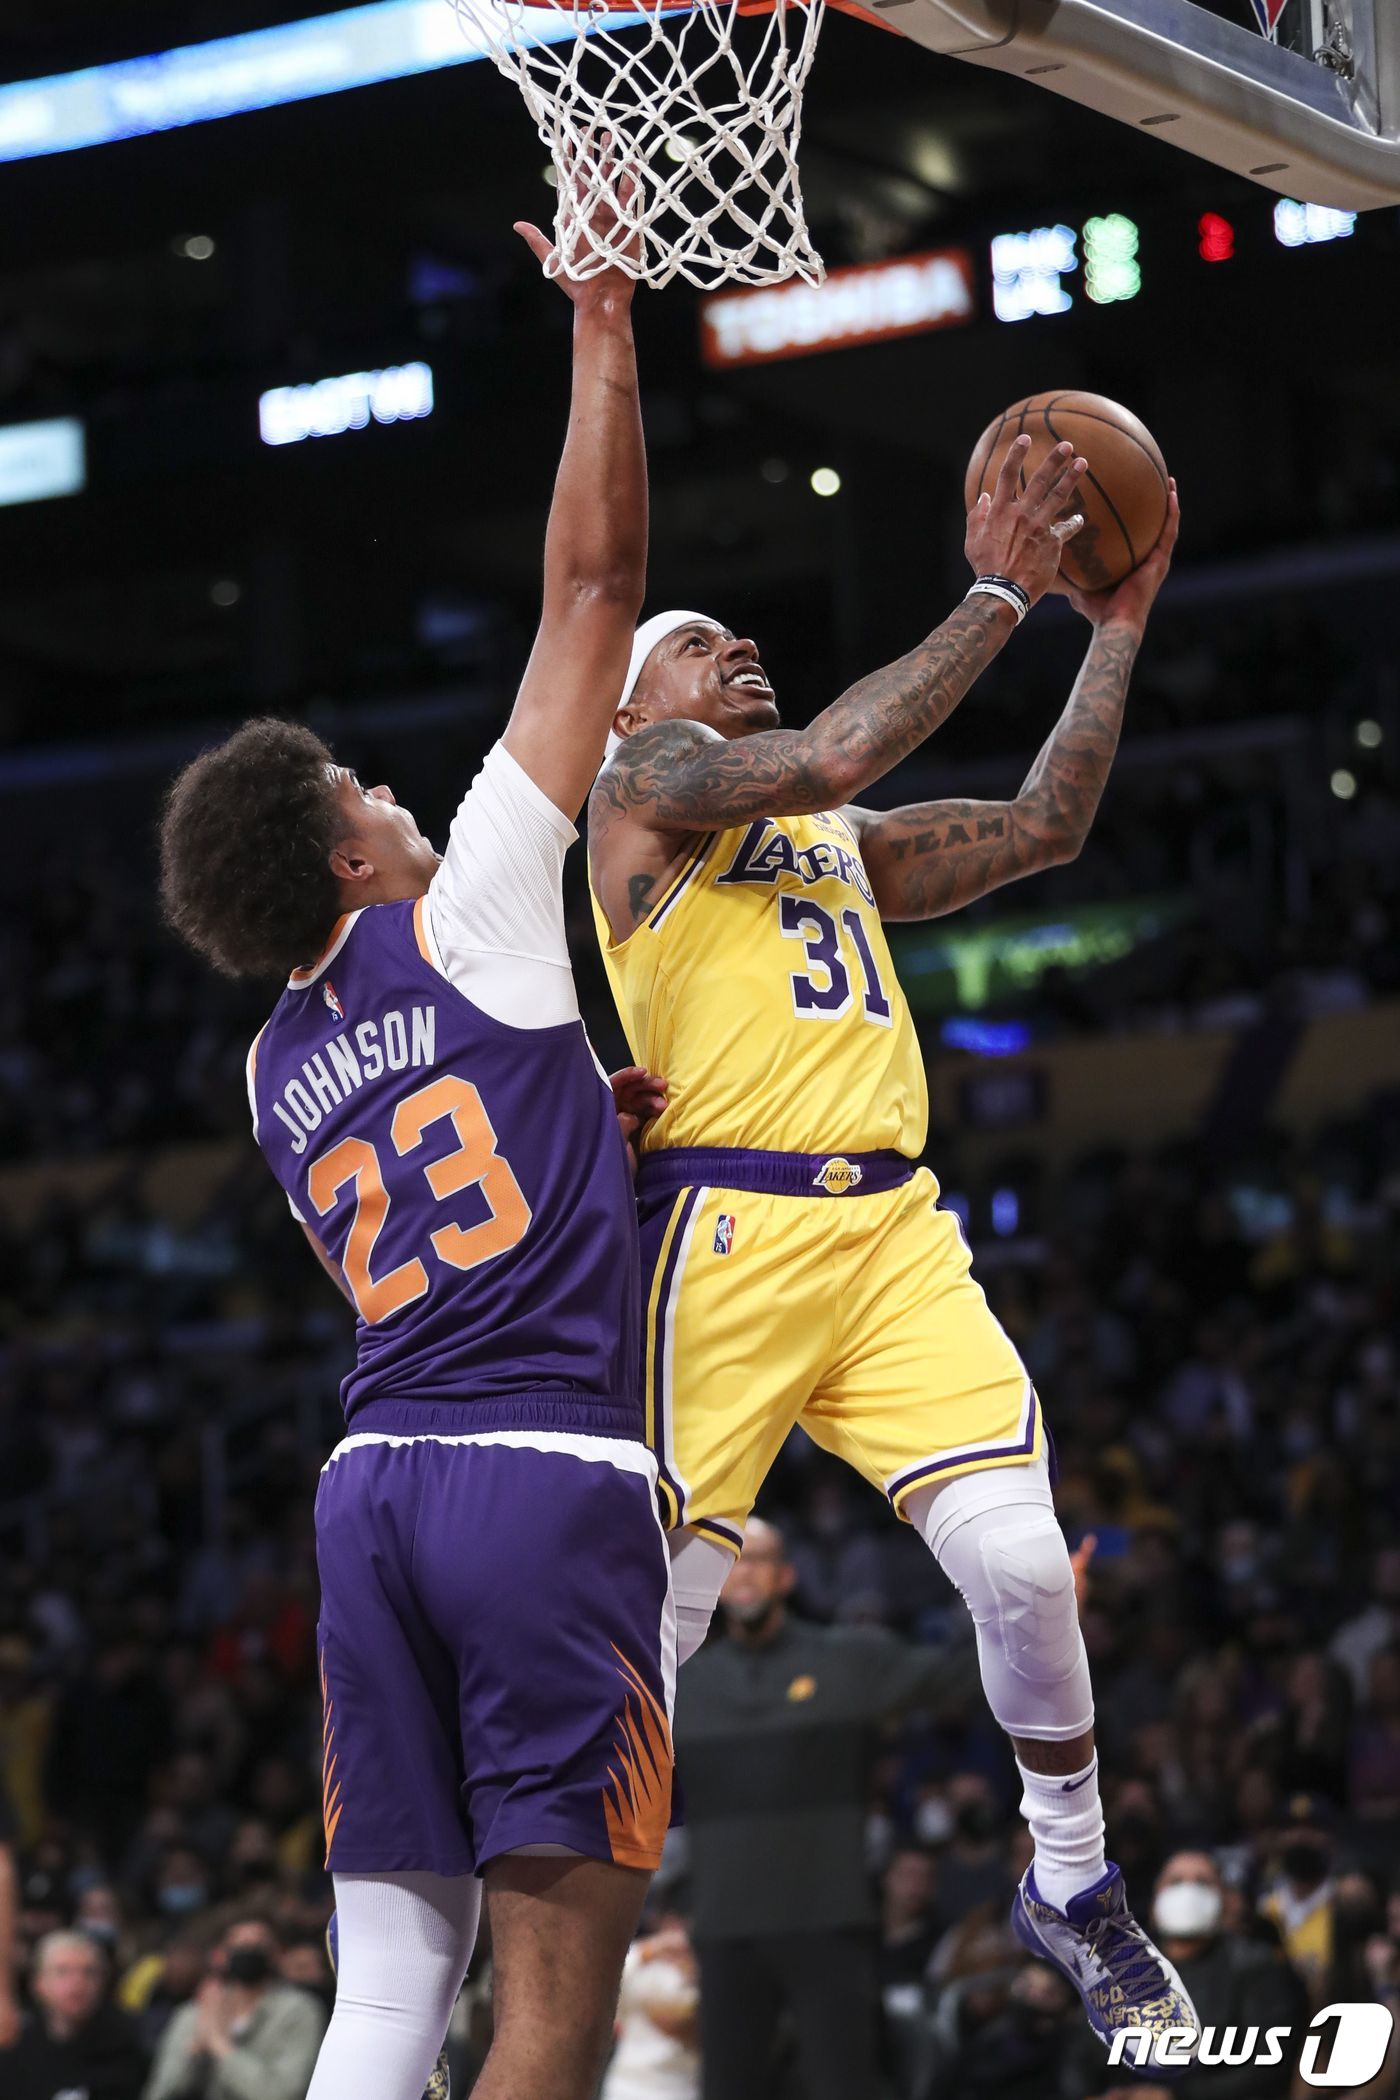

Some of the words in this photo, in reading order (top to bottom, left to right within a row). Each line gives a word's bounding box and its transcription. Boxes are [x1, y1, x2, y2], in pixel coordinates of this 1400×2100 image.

[888, 817, 1004, 860] TEAM
[779, 892, 893, 1029] 31
[272, 1005, 437, 1155] JOHNSON
[307, 1074, 533, 1325] 23
[814, 1166, 862, 1186] LAKERS
